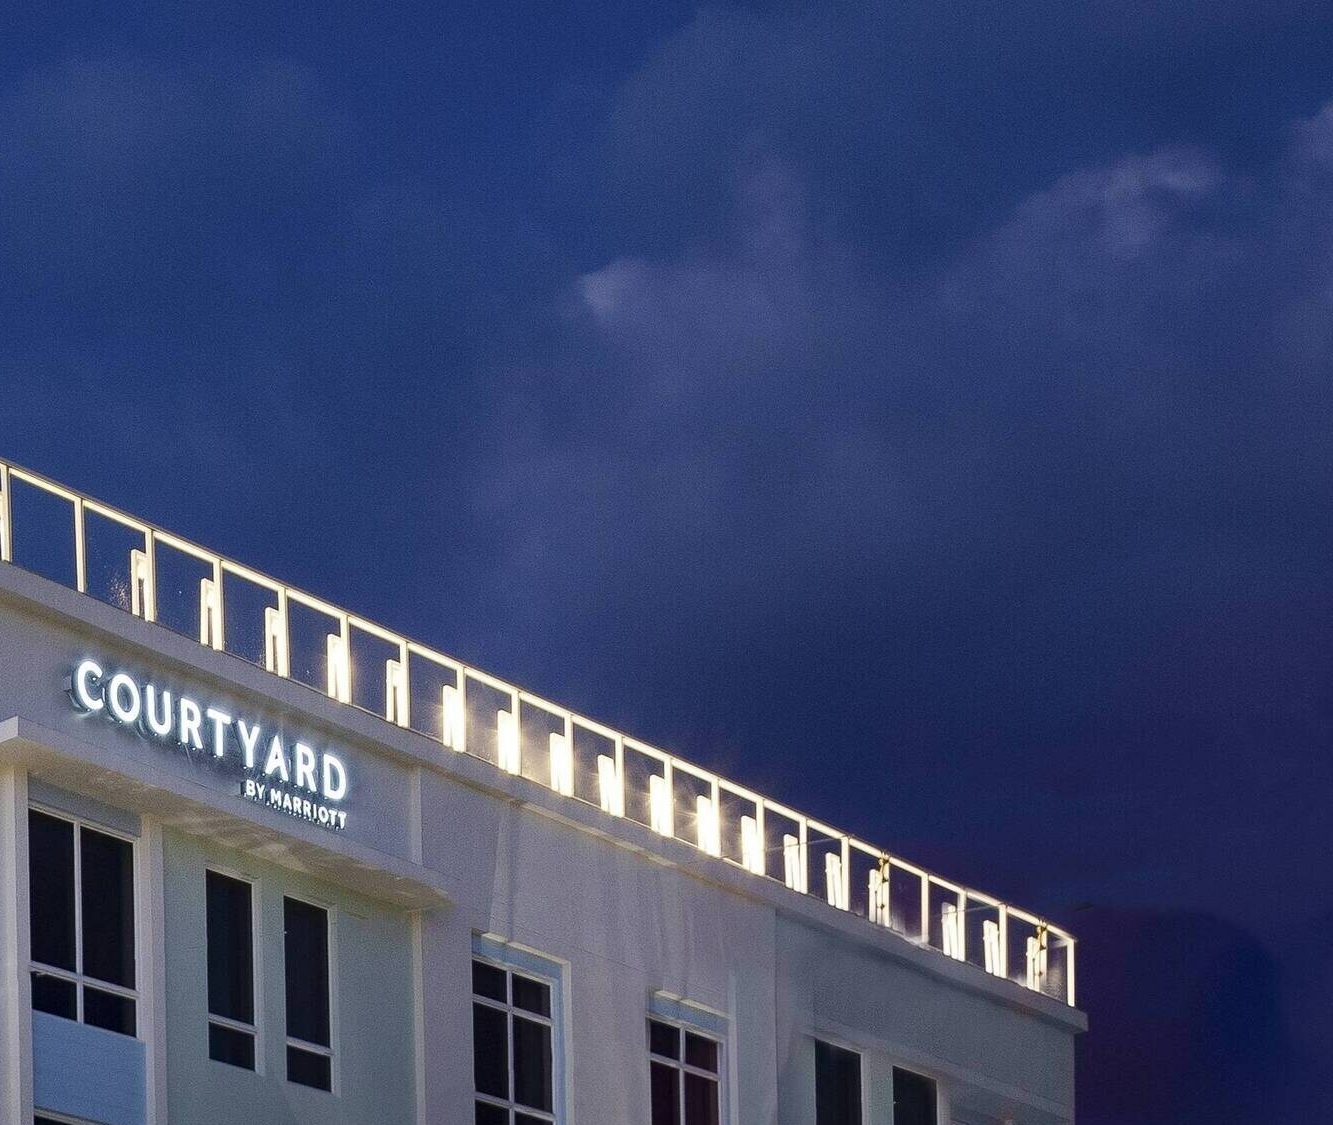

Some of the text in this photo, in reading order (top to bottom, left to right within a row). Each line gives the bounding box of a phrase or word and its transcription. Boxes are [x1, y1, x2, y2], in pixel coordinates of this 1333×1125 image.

[74, 659, 347, 801] COURTYARD
[246, 779, 347, 829] BY MARRIOTT
